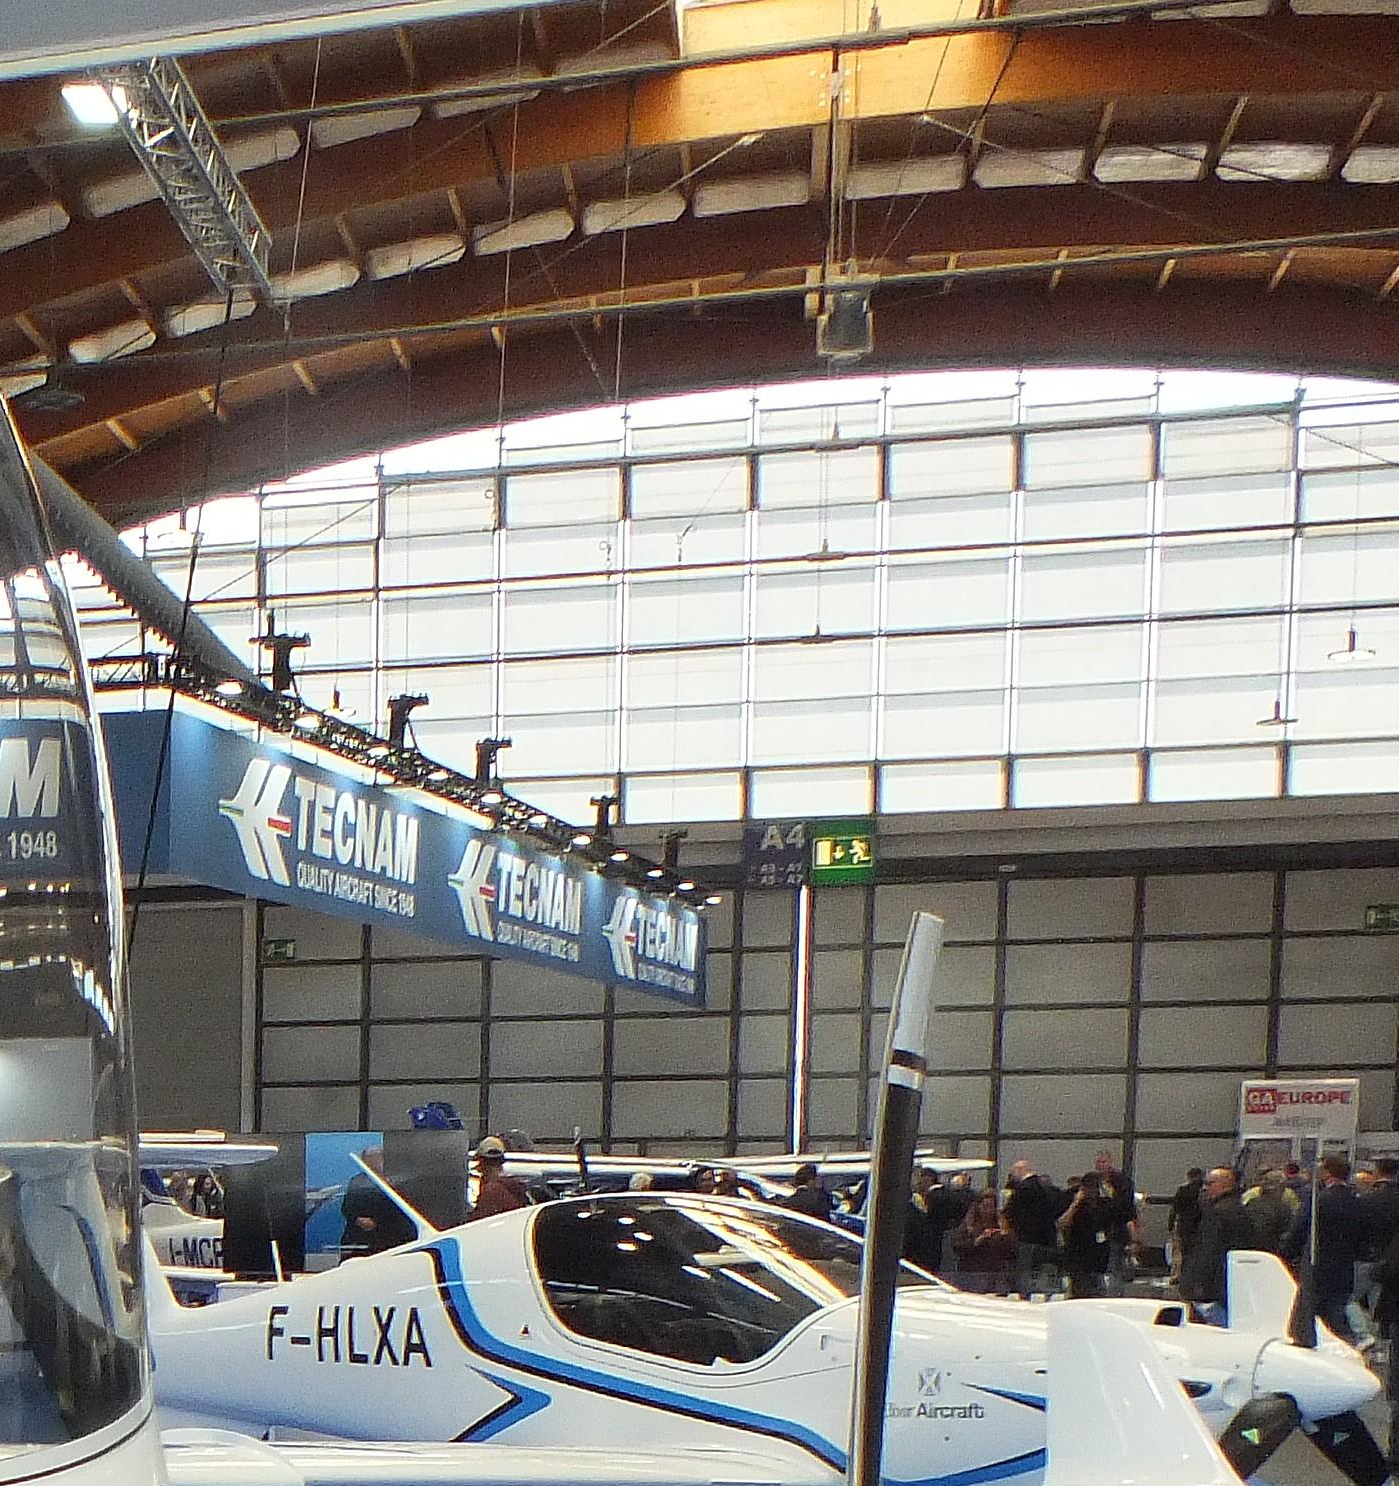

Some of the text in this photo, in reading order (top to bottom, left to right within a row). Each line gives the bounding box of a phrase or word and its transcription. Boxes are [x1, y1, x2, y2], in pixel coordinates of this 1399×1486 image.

[6, 831, 58, 860] 1948
[295, 776, 419, 885] TECNAM
[761, 824, 805, 850] A4
[497, 852, 583, 935] TECNAM
[637, 904, 698, 971] TECNAM
[1277, 1090, 1351, 1105] EUROPE
[267, 1305, 432, 1367] F-HLXA
[917, 1403, 985, 1418] Aircraft
